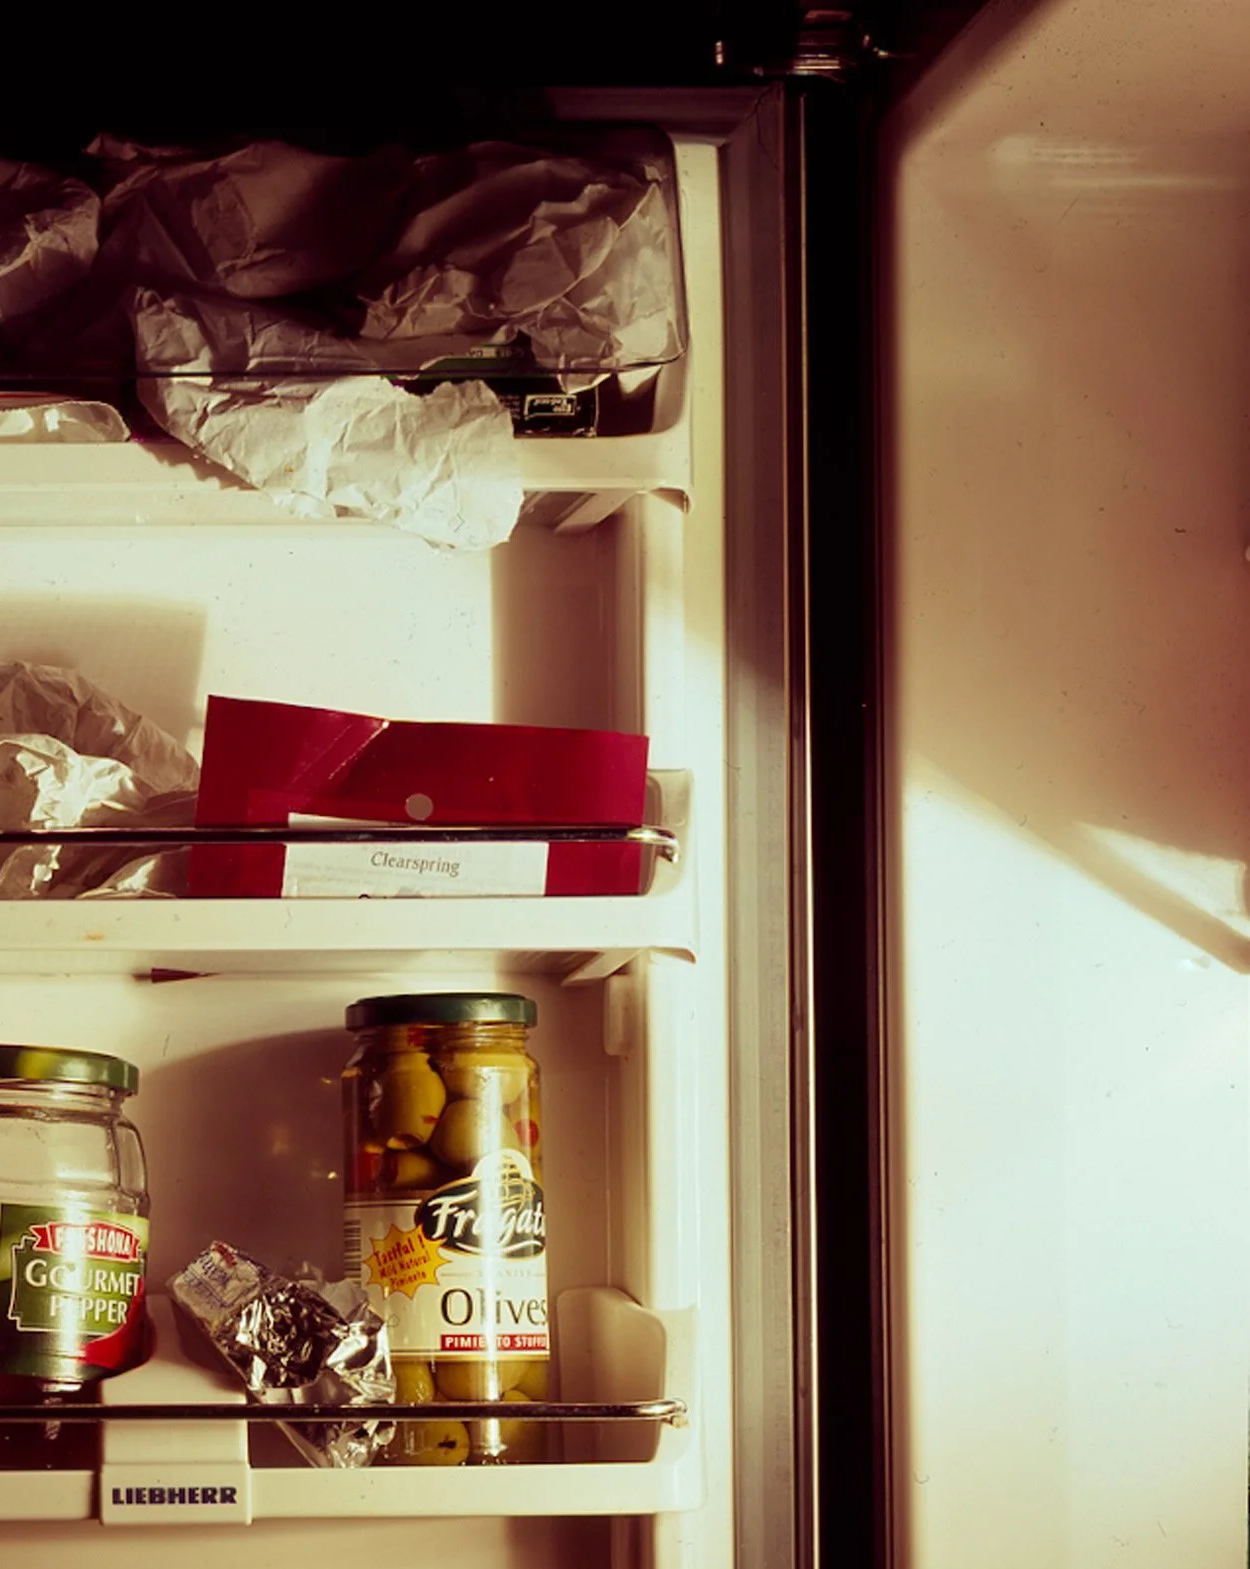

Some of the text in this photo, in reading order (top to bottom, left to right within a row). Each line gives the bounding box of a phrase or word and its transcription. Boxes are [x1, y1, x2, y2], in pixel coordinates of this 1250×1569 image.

[370, 850, 461, 877] Clearspring
[55, 1226, 136, 1259] FSHONA
[50, 1295, 128, 1325] PPPER
[445, 1336, 511, 1348] PIMIETO
[111, 1487, 237, 1505] LIEBHERR
